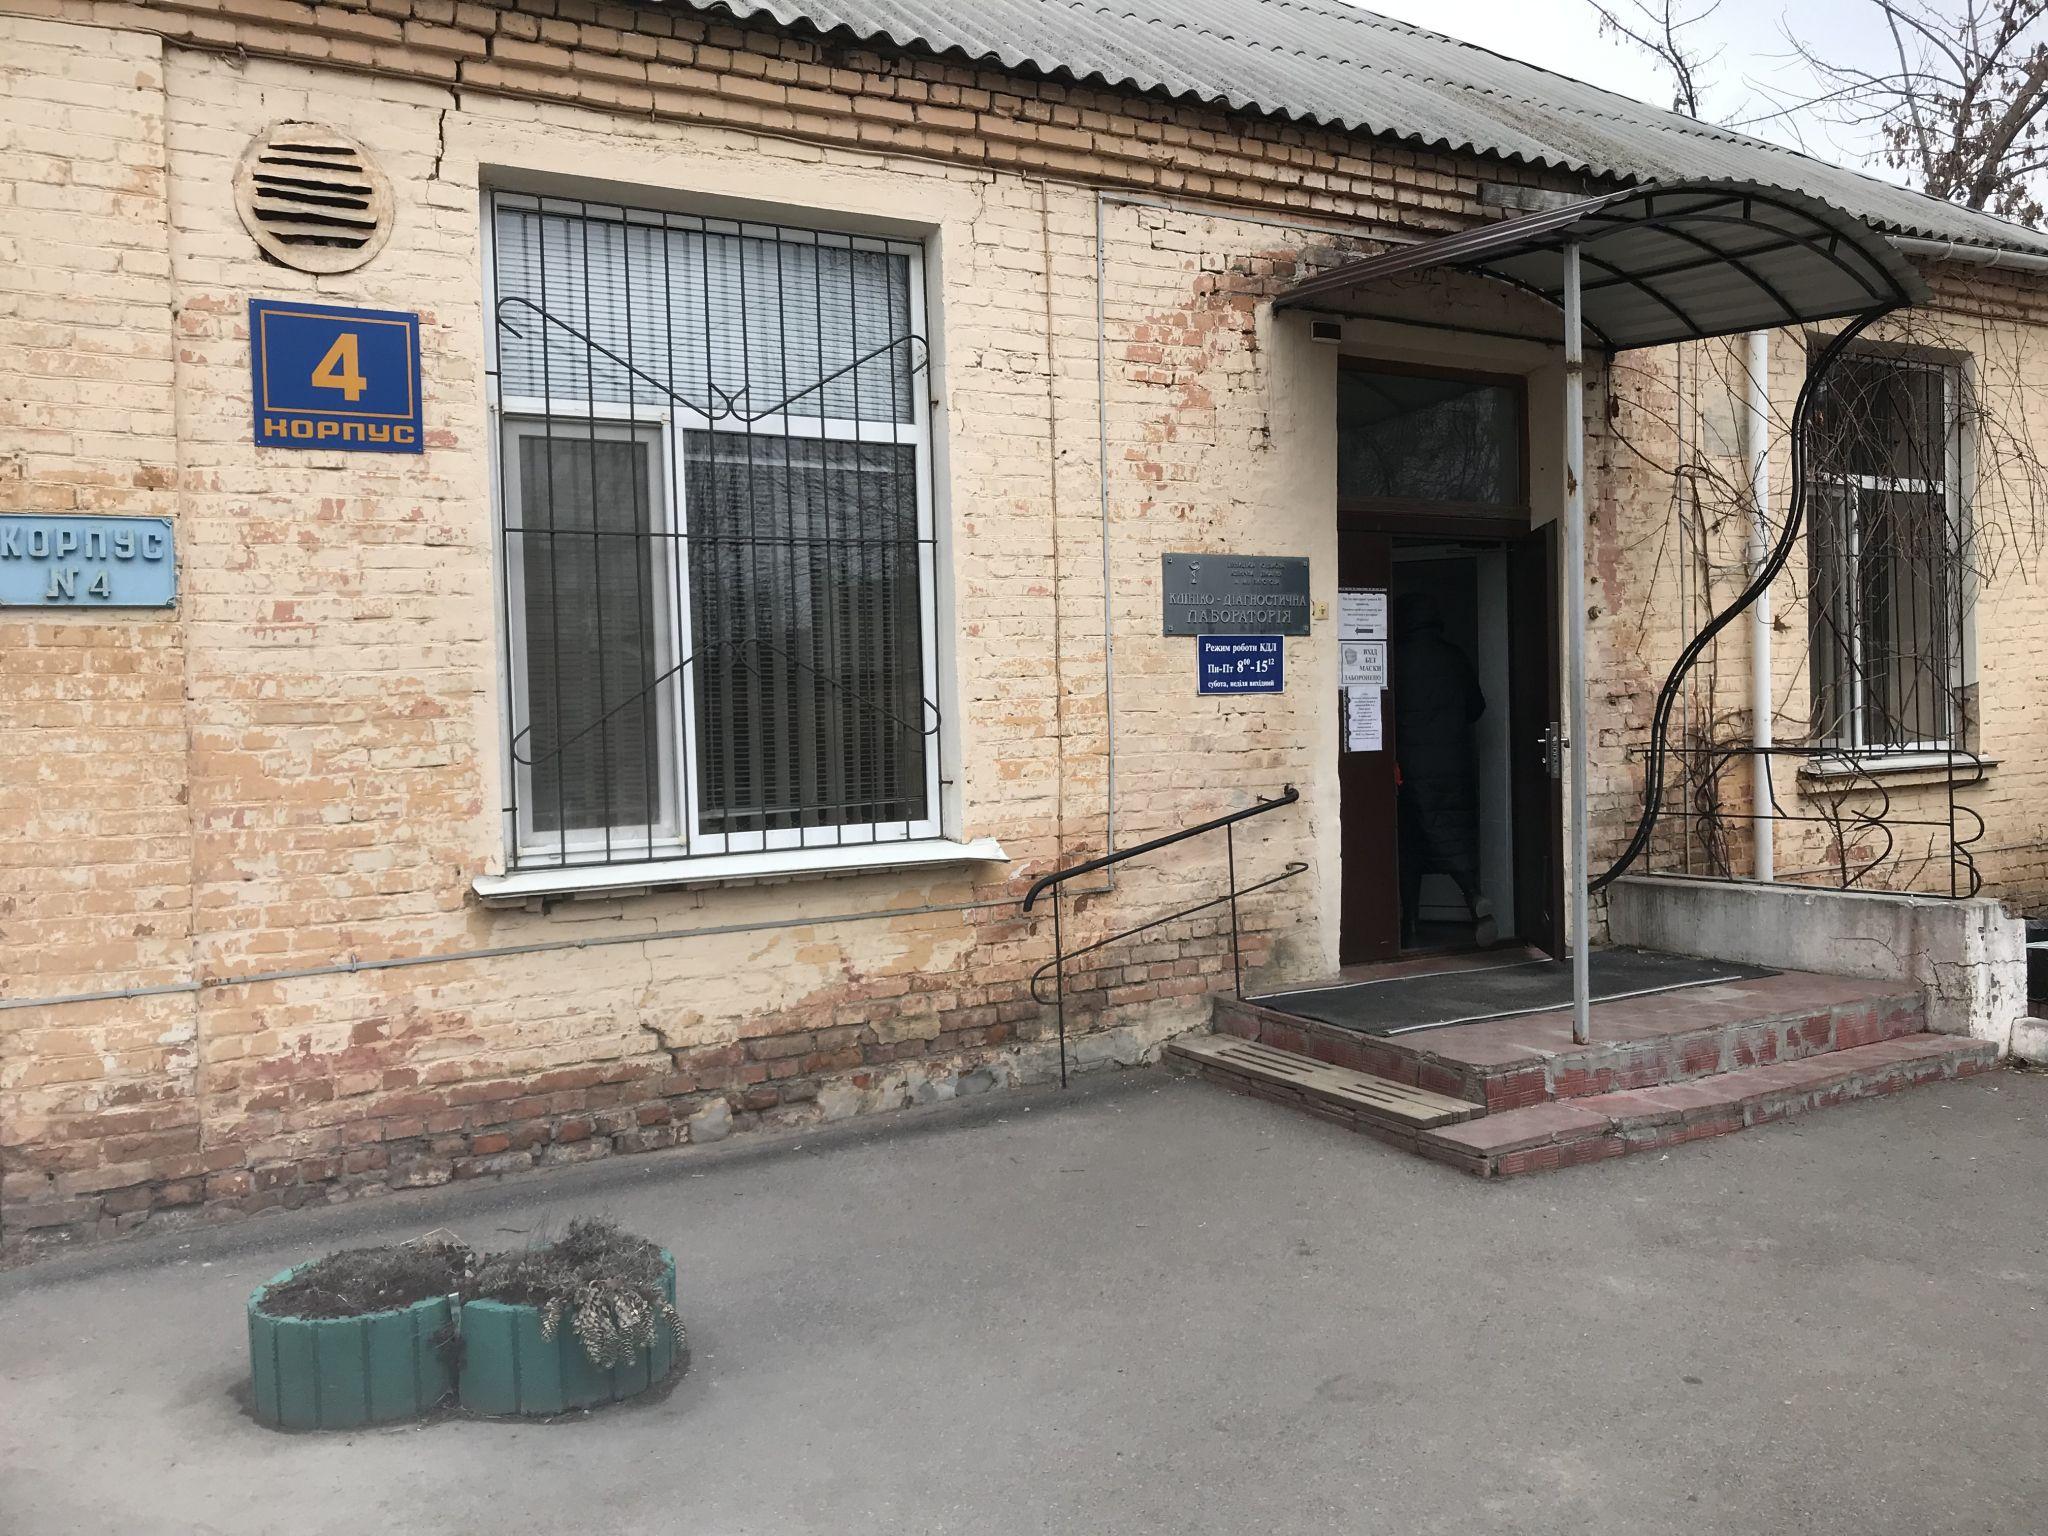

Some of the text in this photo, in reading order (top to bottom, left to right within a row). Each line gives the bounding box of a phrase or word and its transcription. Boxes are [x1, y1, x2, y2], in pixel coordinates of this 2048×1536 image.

[311, 333, 367, 402] 4
[264, 418, 415, 444] КОРПУС
[0, 526, 164, 561] КОРПУС
[89, 568, 112, 599] 4
[1187, 609, 1292, 624] ЛАБОРАТОРІЯ
[1205, 642, 1277, 654] Режим роботи КДЛ
[1207, 664, 1234, 673] Пн-Пт
[1207, 680, 1229, 689] субота,
